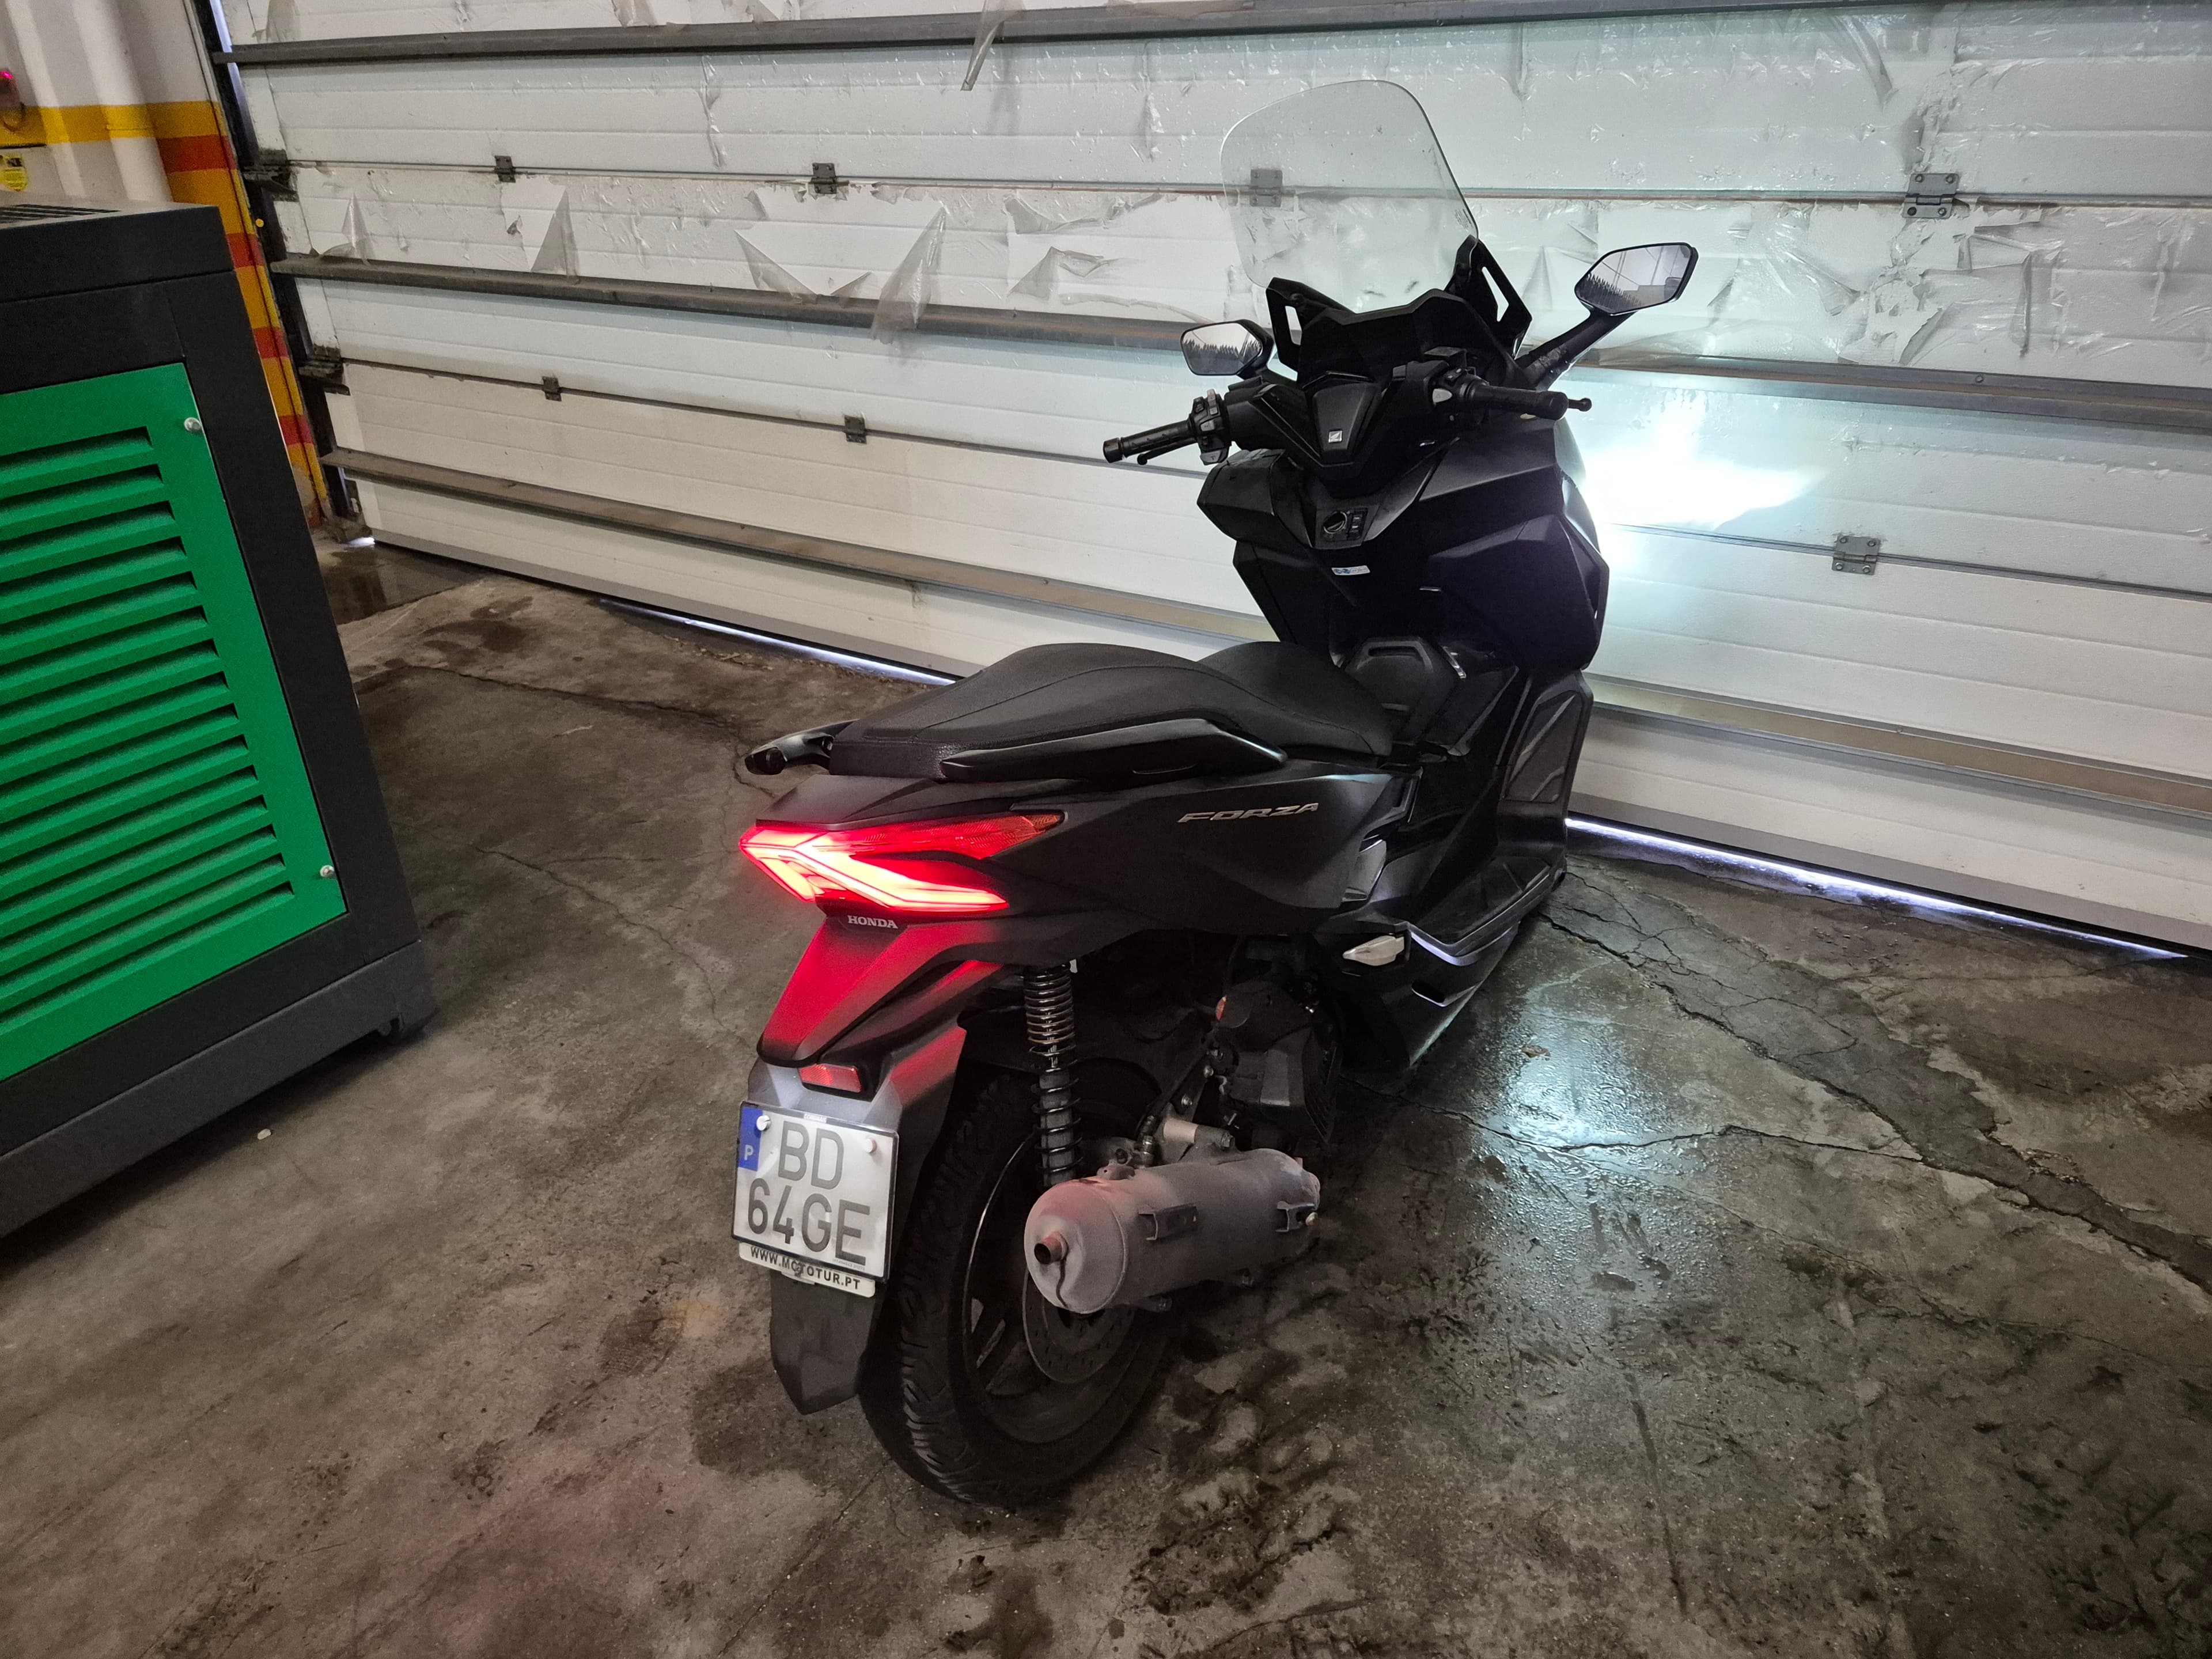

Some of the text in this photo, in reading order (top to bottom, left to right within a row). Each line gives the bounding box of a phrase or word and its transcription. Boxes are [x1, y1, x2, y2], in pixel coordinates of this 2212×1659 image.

[1177, 802, 1319, 823] FORZA
[847, 915, 899, 929] HONDA
[744, 1145, 754, 1161] P
[778, 1120, 844, 1190] BD
[748, 1178, 870, 1266] 64GE
